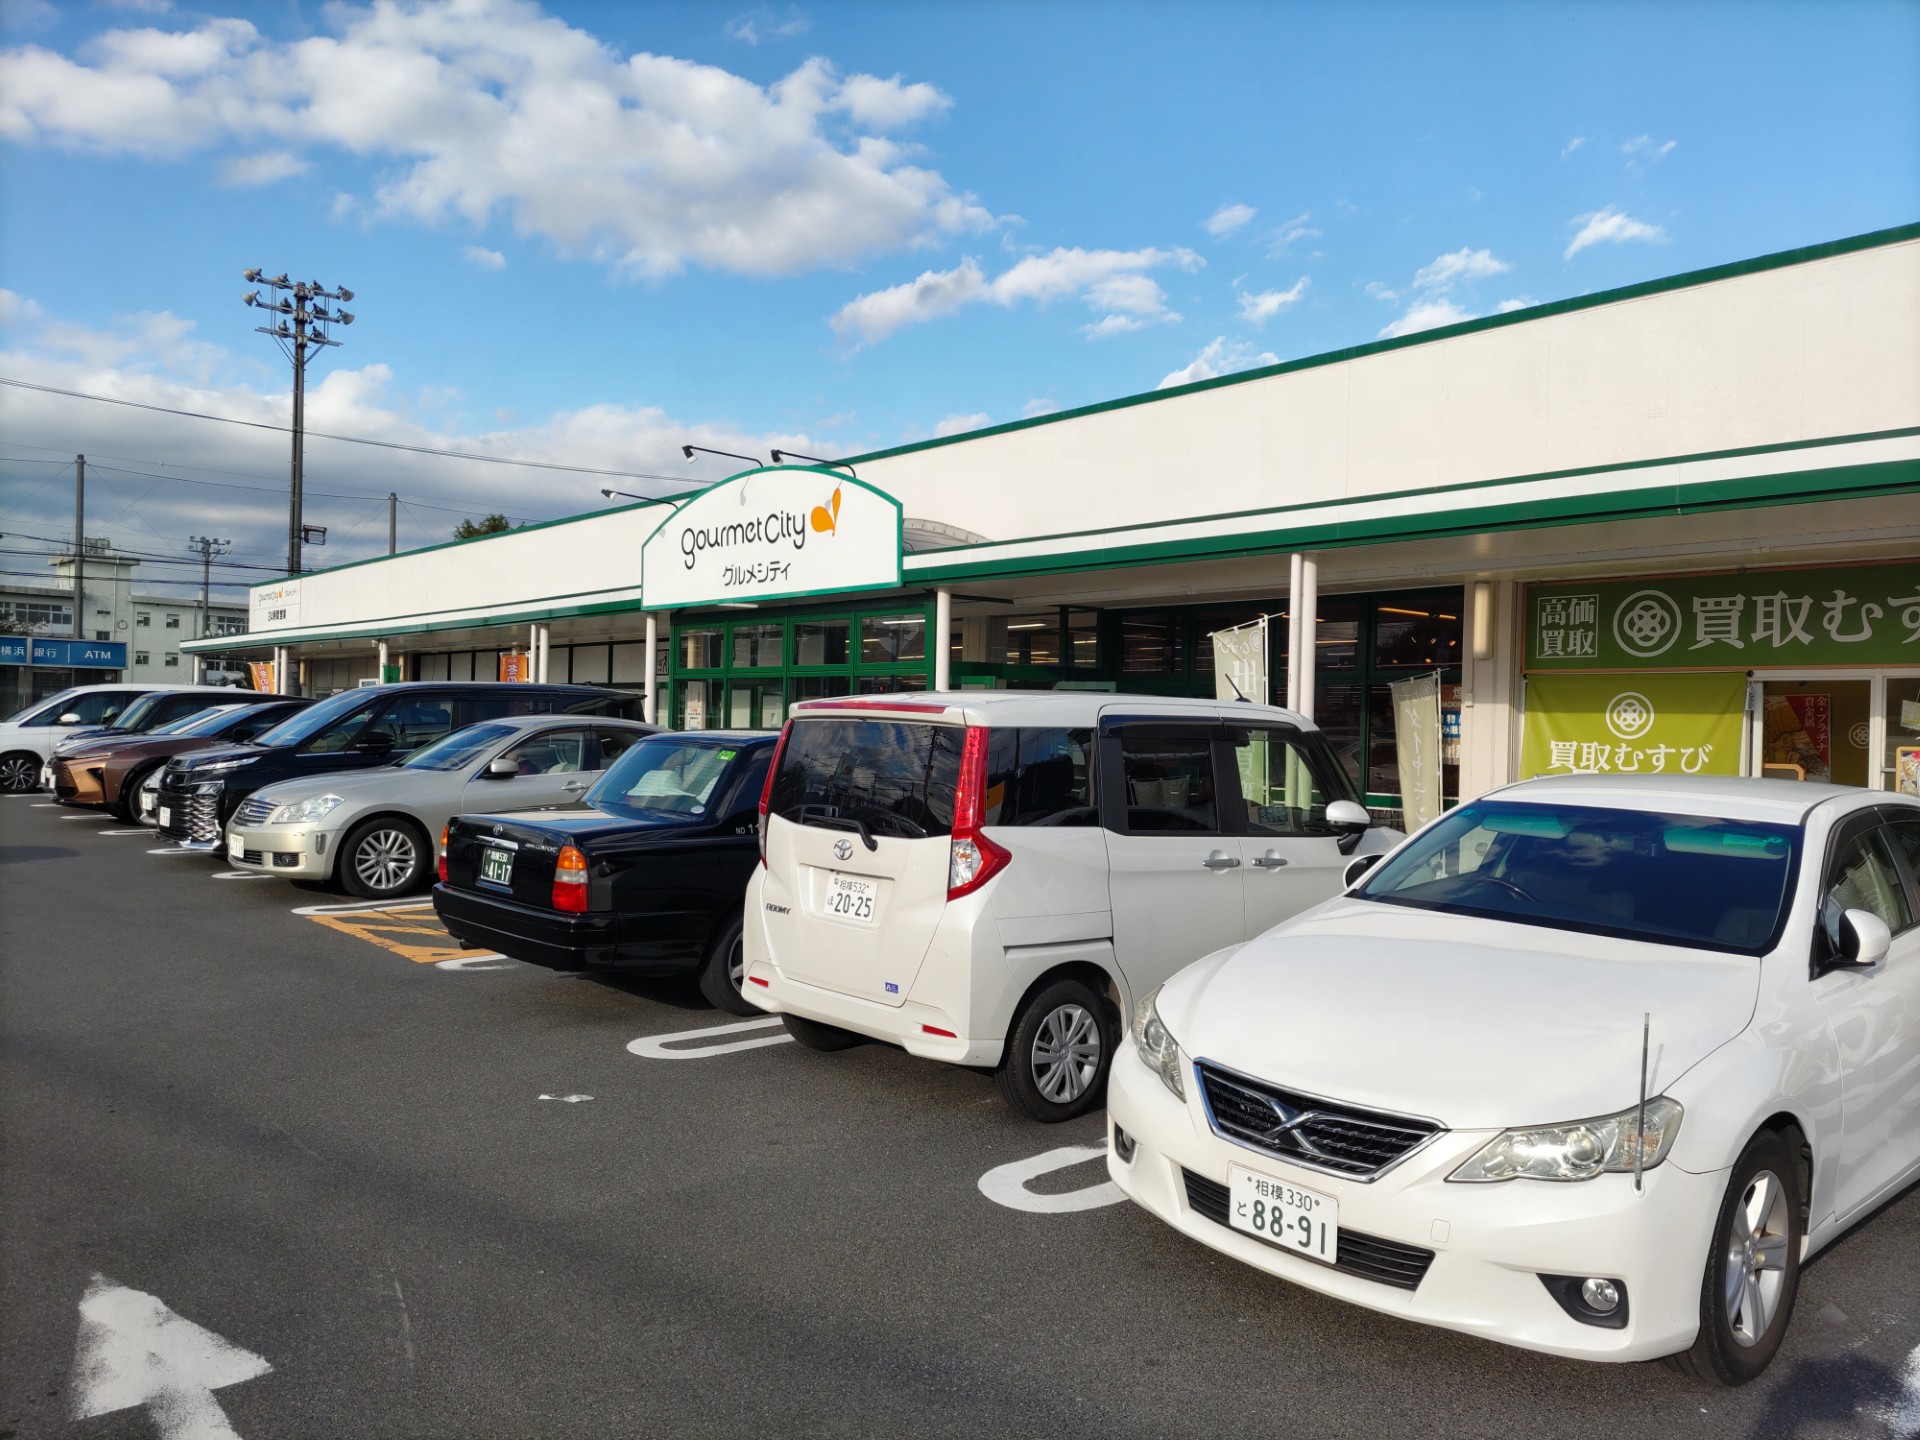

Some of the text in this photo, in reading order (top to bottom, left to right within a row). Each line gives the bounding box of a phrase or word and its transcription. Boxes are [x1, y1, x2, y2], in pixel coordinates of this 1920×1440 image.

[681, 510, 805, 570] gourmetCity
[722, 561, 791, 586] グルメシティ
[1541, 598, 1595, 626] 高価
[84, 650, 111, 660] ATM
[1541, 628, 1595, 657] 買取
[1547, 740, 1713, 774] 買取むすび
[1255, 1179, 1312, 1211] 相模 330
[1237, 1200, 1326, 1255] と 88-91
